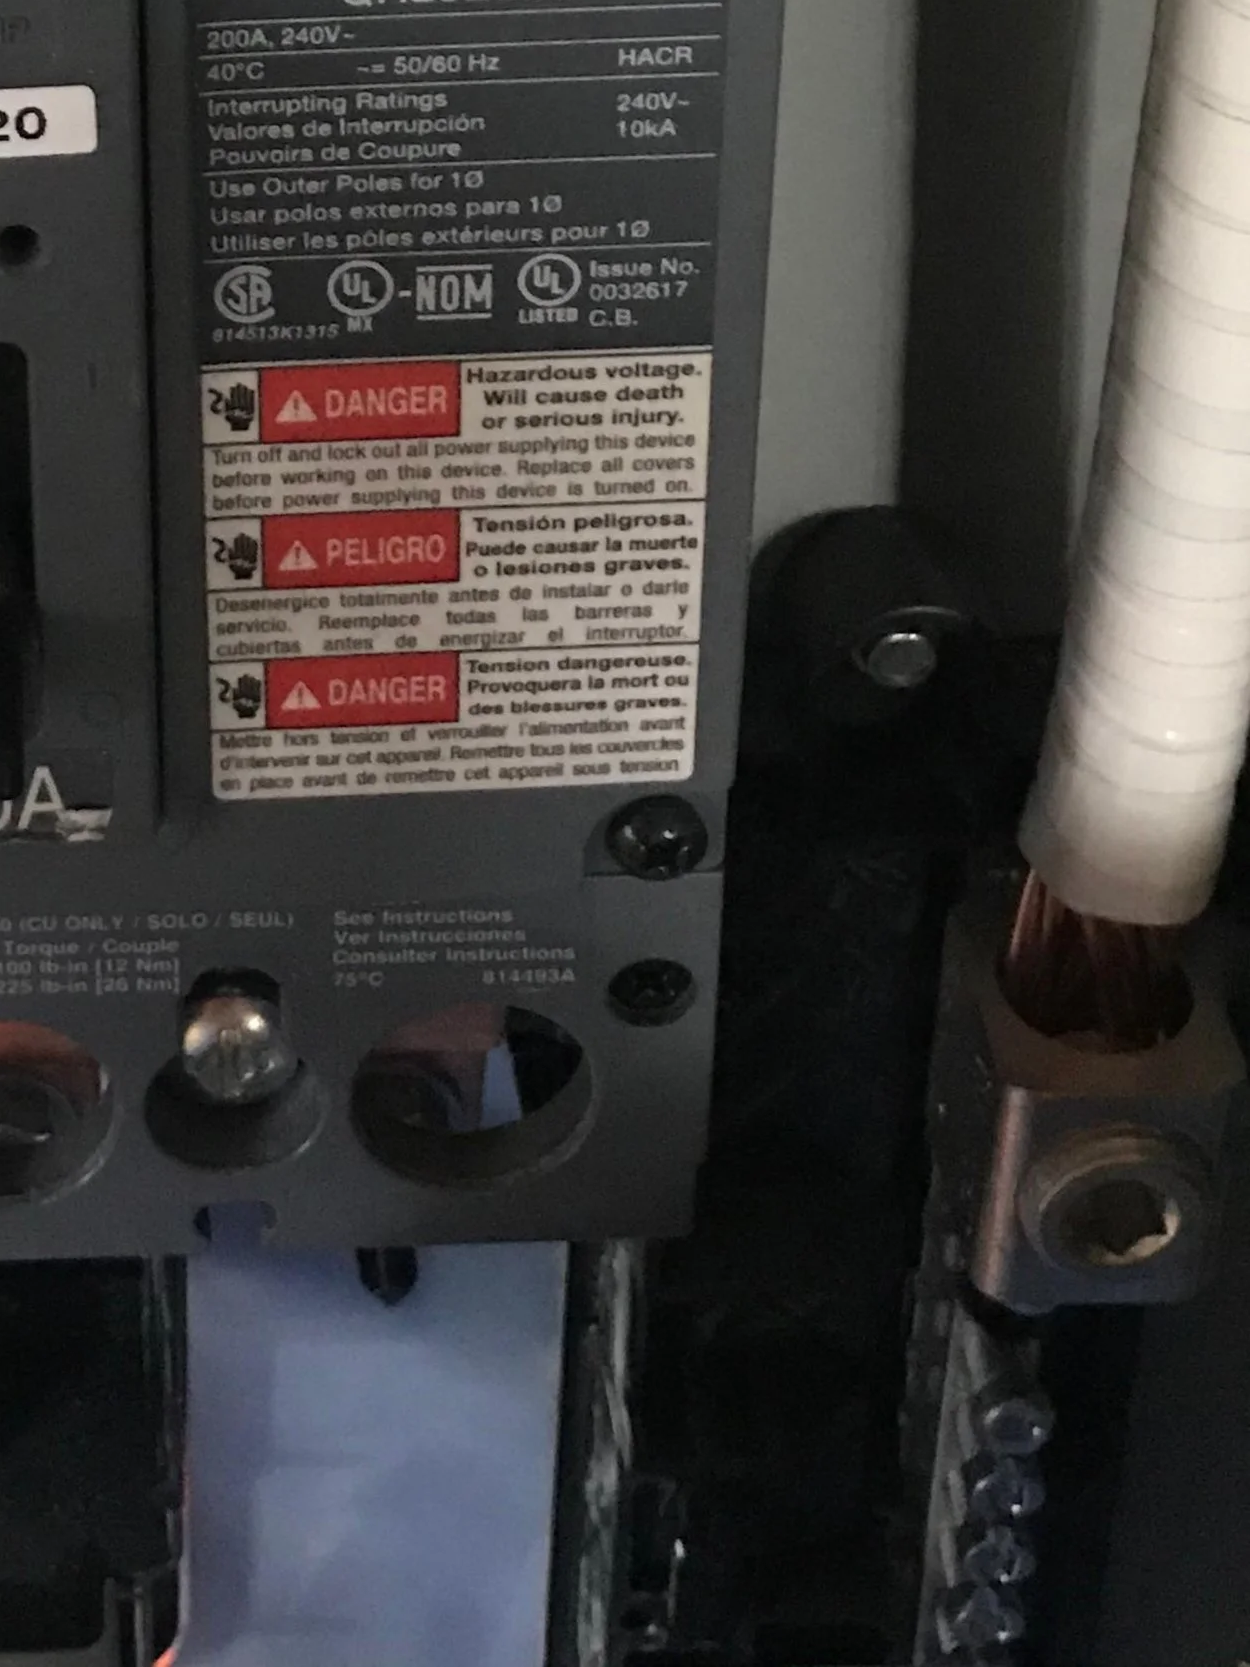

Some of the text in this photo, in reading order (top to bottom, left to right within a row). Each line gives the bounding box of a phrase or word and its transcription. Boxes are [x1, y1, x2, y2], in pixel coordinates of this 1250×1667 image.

[207, 54, 500, 81] 40°C 50/60 Hz
[618, 46, 693, 66] HACR
[207, 92, 448, 117] Interrupting Ratings
[207, 113, 486, 141] Valores de Interrupción
[617, 118, 676, 139] 10kA
[210, 142, 462, 166] Pouvoirs de Coupure
[210, 179, 255, 198] Use
[263, 177, 330, 196] Outer
[336, 174, 403, 193] Poles
[410, 173, 443, 190] for
[210, 207, 267, 225] Usar
[274, 203, 342, 225] polos
[350, 201, 457, 219] externos
[465, 200, 520, 219] para
[210, 233, 296, 253] Utiliser
[303, 231, 339, 249] les
[421, 226, 543, 247] extérieurs
[551, 225, 608, 245] pour
[589, 258, 700, 278] Issue No.
[416, 272, 492, 312] NOM
[589, 281, 688, 301] 0032617
[466, 362, 702, 384] Hazardous voltage.
[325, 385, 448, 418] DANGER
[484, 384, 684, 406] Will cause death
[482, 409, 684, 430] or serious injury.
[212, 431, 695, 466] Turn off and lock out all power supplying this device
[212, 469, 271, 488] before
[280, 465, 356, 485] working
[365, 466, 388, 481] on
[397, 462, 432, 480] this
[517, 458, 592, 476] Replace
[602, 457, 623, 472] all
[632, 454, 695, 472] covers
[212, 491, 271, 511] before
[283, 491, 340, 510] power
[352, 487, 441, 506] supplying
[452, 482, 485, 500] this
[496, 480, 557, 499] device
[567, 481, 582, 496] is
[594, 477, 655, 495] turned
[474, 513, 693, 534] Tensión peligrosa.
[326, 534, 446, 566] PELIGRO
[466, 535, 698, 557] Puede causar la muerte
[474, 557, 690, 577] o lesiones graves.
[215, 595, 330, 613] Desenergice
[339, 589, 439, 608] totalmente
[448, 586, 500, 603] antes
[509, 585, 532, 601] de
[543, 582, 612, 599] instalar
[318, 613, 421, 630] Reemplace
[446, 609, 497, 625] todas
[522, 606, 549, 622] las
[575, 604, 653, 621] barreras
[678, 603, 688, 620] y
[216, 639, 301, 657] cubiertas
[322, 636, 374, 652] antes
[394, 634, 418, 649] de
[440, 630, 526, 652] energizar
[548, 626, 563, 642] el
[467, 654, 692, 674] Tension dangereuse.
[328, 675, 446, 707] DANGER
[467, 674, 689, 695] Provoquera la mort ou
[468, 696, 687, 716] des blessures graves.
[64, 915, 123, 932] ONLY
[149, 912, 207, 930] SOLO
[382, 909, 514, 925] Instructions
